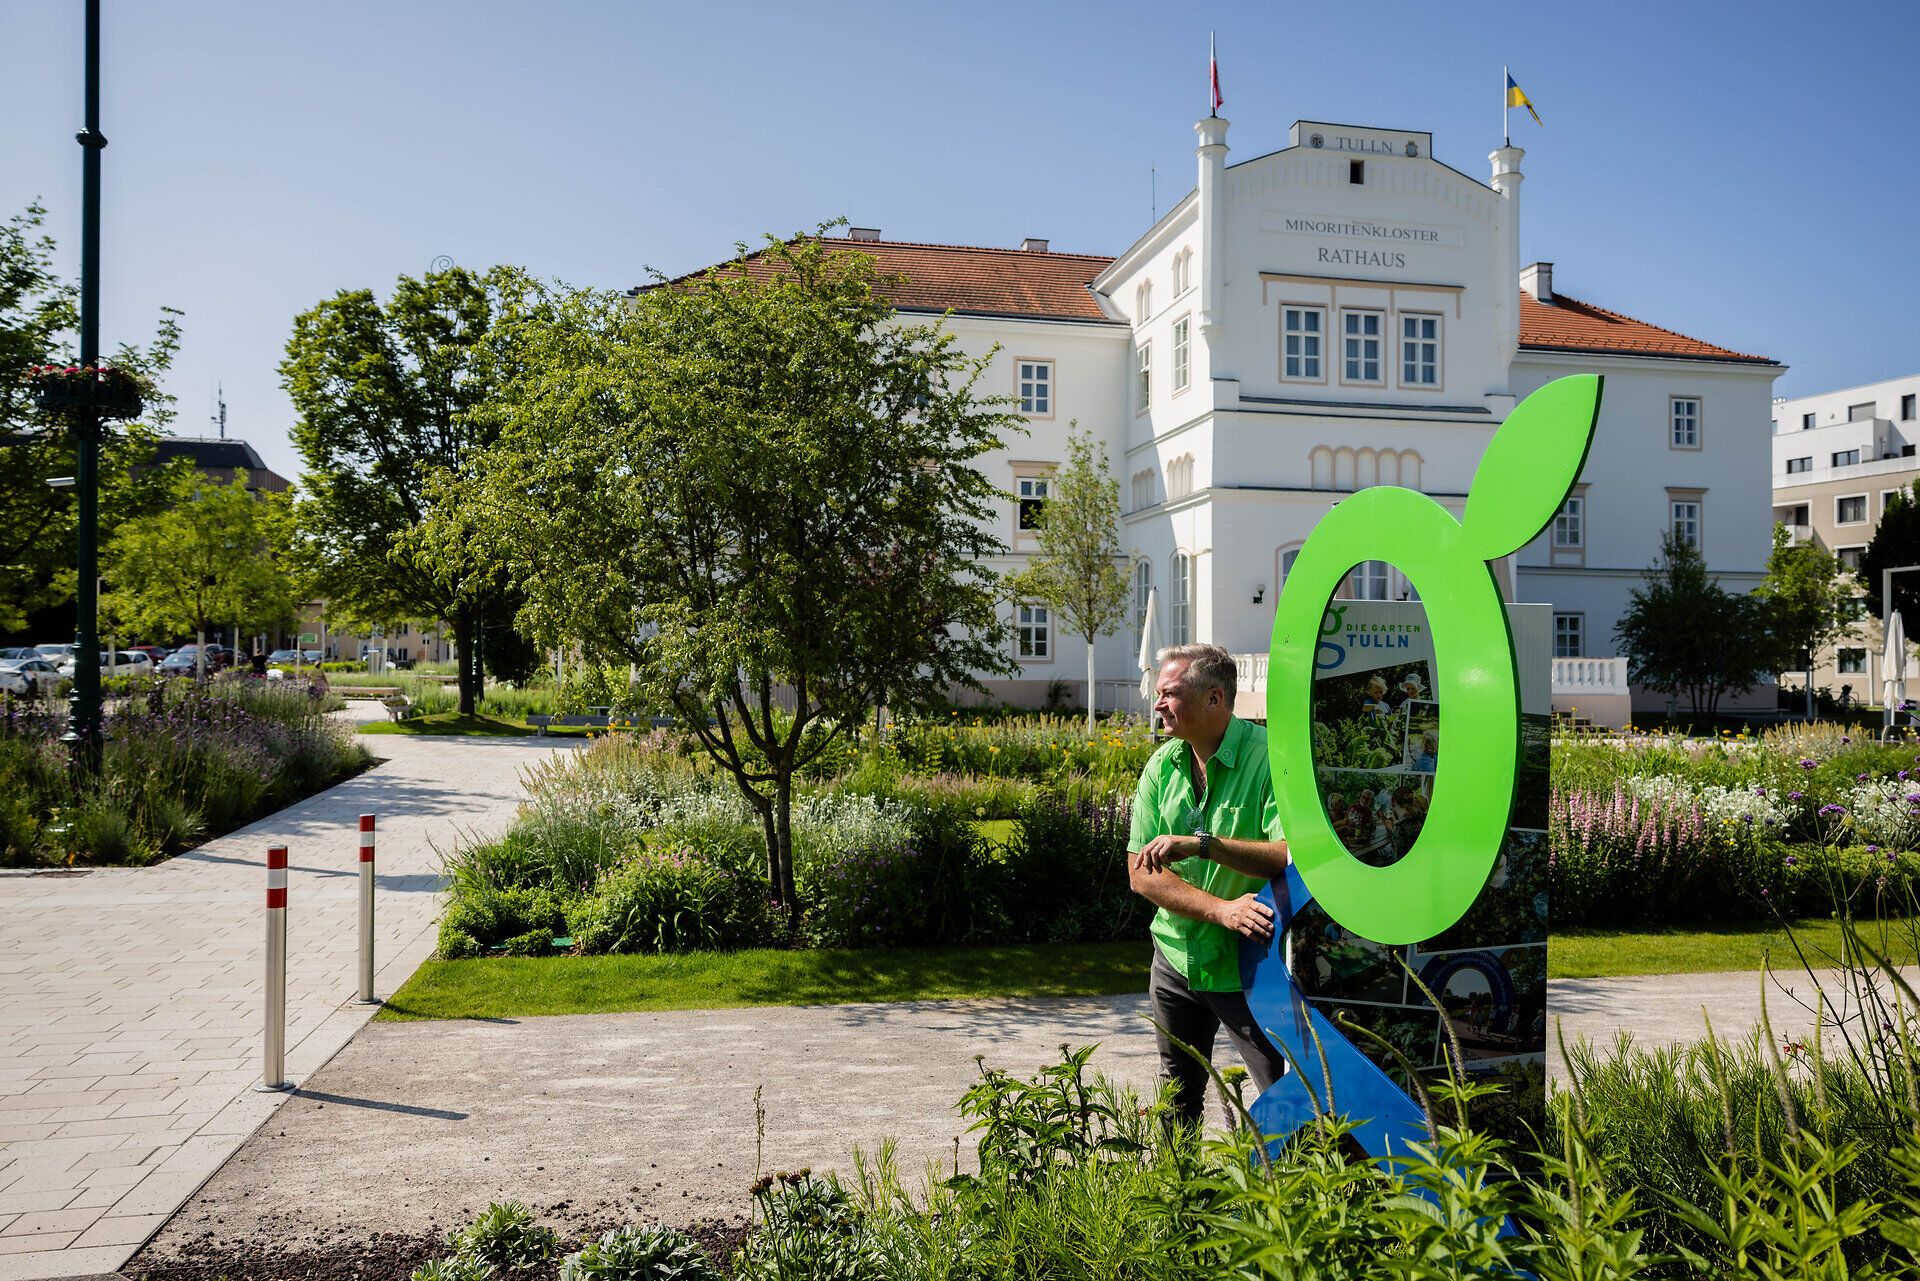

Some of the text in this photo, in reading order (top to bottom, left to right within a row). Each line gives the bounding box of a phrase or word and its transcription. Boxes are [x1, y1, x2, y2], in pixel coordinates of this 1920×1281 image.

[1336, 137, 1393, 153] TULLN
[1285, 219, 1440, 242] MINORITENKLOSTER
[1317, 247, 1406, 268] RATHAUS
[1346, 624, 1421, 632] DIE GARTEN
[1346, 634, 1409, 648] TULLN
